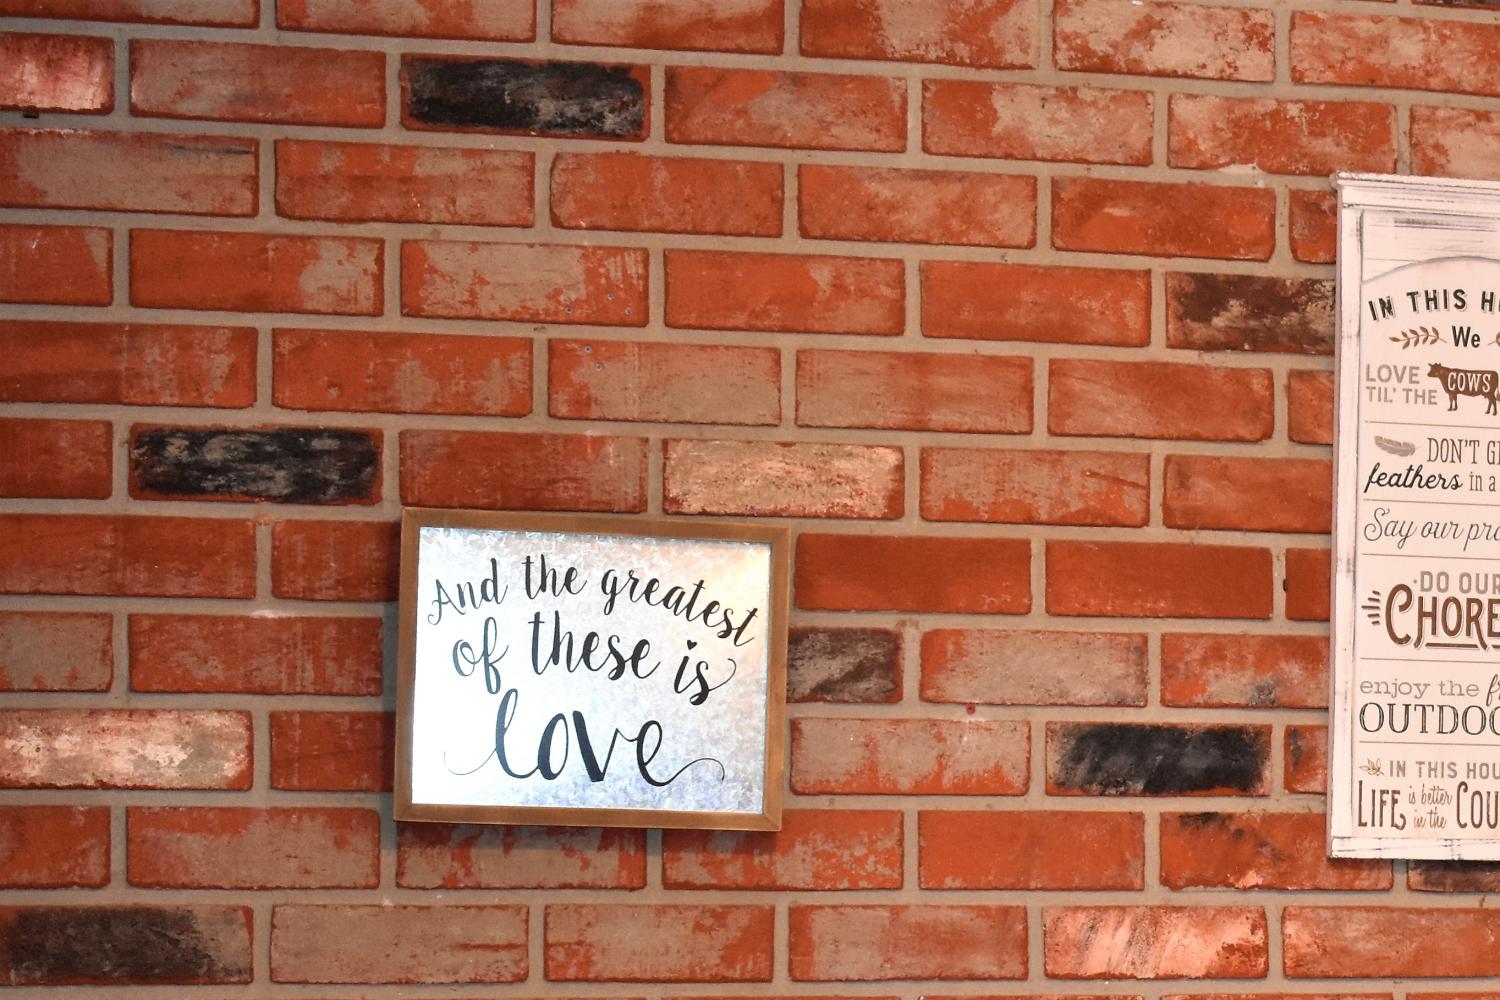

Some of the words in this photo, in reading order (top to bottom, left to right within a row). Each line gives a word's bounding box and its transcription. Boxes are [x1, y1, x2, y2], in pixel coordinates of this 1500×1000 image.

[1368, 296, 1394, 322] IN
[1406, 288, 1467, 314] THIS
[1452, 325, 1481, 348] We
[1365, 364, 1420, 384] LOVE
[1447, 371, 1491, 393] COWS
[1402, 388, 1437, 405] THE
[1427, 438, 1479, 464] DON'T
[1364, 462, 1463, 493] feathers
[1469, 471, 1483, 491] in
[1488, 475, 1497, 492] a
[1364, 507, 1417, 549] Say
[1421, 521, 1464, 539] our
[1420, 571, 1450, 594] DO
[427, 557, 508, 625] And
[522, 553, 587, 600] the
[601, 568, 759, 647] greatest
[452, 616, 509, 695] of
[528, 610, 661, 681] these
[674, 639, 737, 706] is
[1360, 678, 1430, 700] enjoy
[1439, 678, 1480, 698] the
[444, 688, 724, 787] love
[1390, 760, 1406, 778] IN
[1416, 761, 1457, 780] THIS
[1358, 780, 1406, 830] LIFE
[1408, 785, 1416, 805] is
[1421, 783, 1453, 805] better
[1413, 809, 1427, 828] in
[1427, 806, 1447, 829] the
